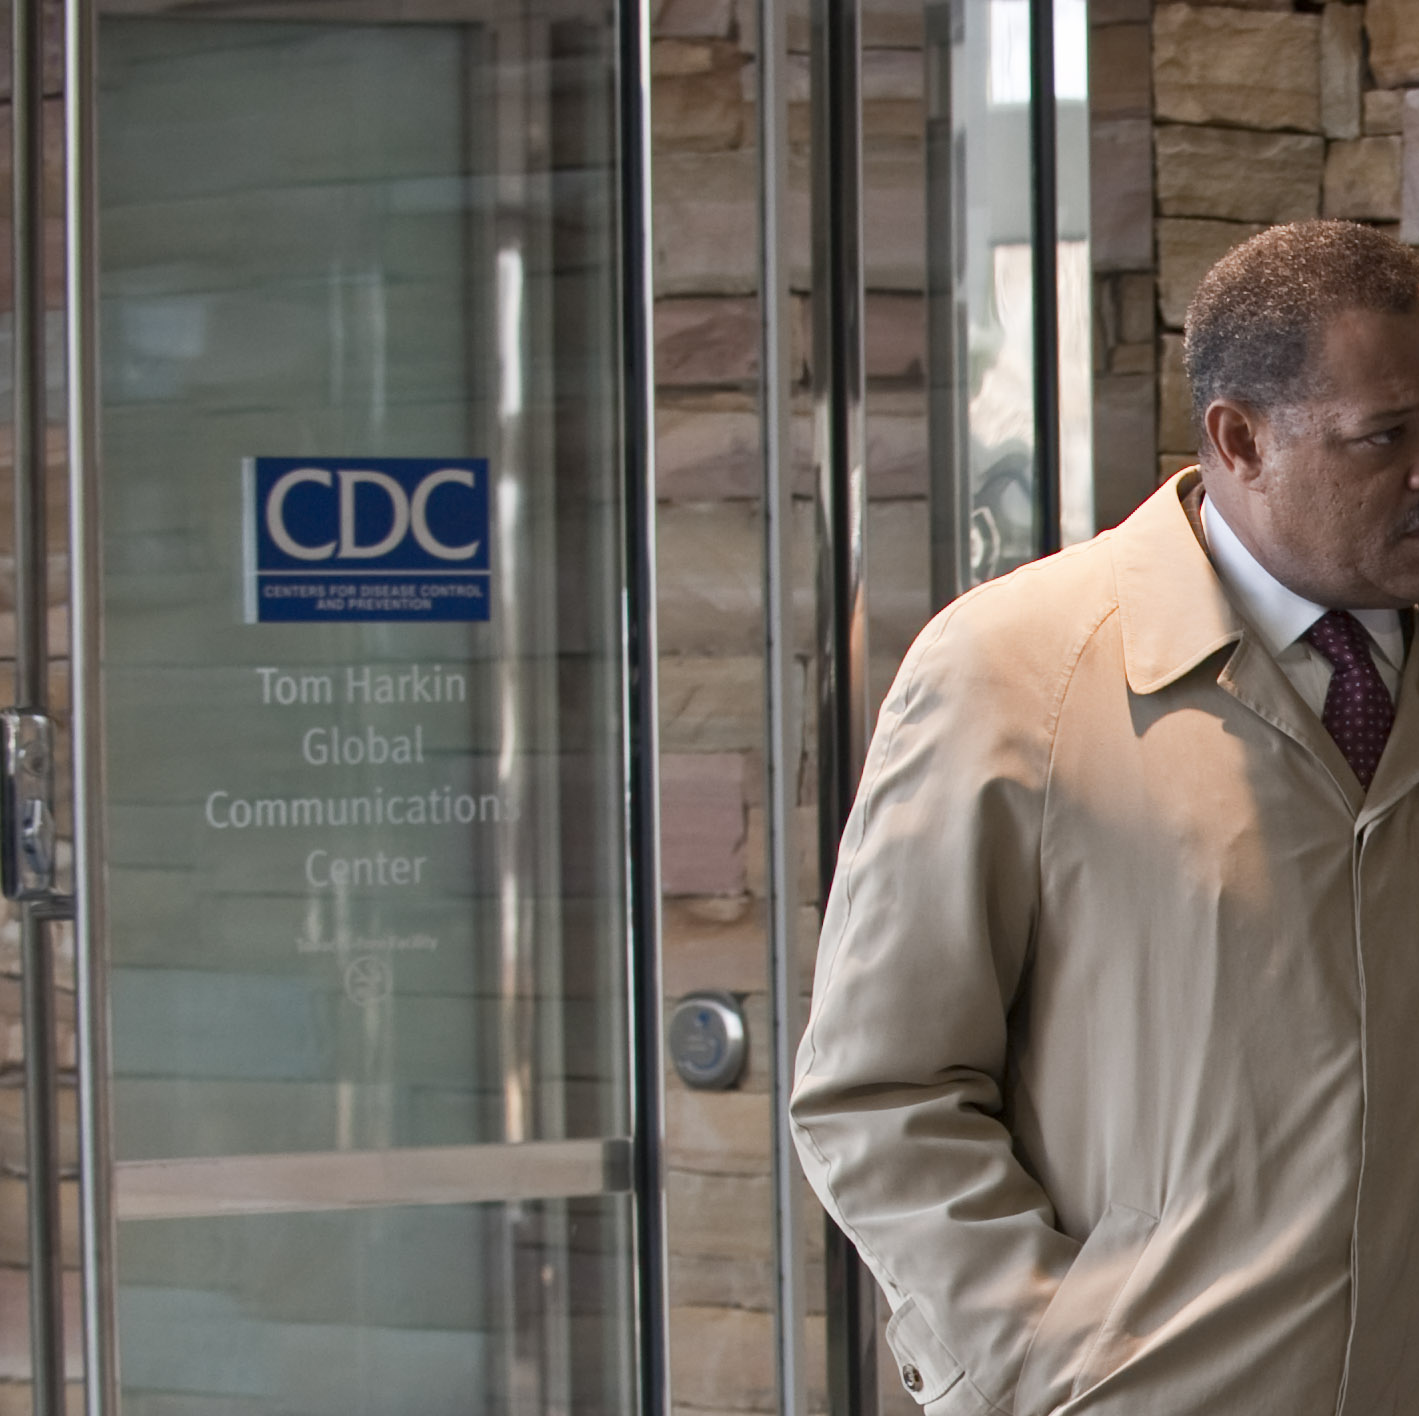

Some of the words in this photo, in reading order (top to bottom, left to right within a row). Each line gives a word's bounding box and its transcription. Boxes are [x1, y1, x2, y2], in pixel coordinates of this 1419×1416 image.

[266, 468, 480, 560] CDC
[263, 585, 325, 598] CENTERS
[328, 585, 356, 598] FOR
[361, 585, 416, 598] DISEASE
[420, 585, 482, 598] CONTROL
[315, 599, 344, 610] AND
[348, 599, 432, 610] PREVENTION
[256, 667, 332, 704] Tom
[347, 665, 466, 702] Harkin
[303, 725, 424, 764] Global
[205, 786, 521, 828] Communications
[305, 850, 427, 888] Center
